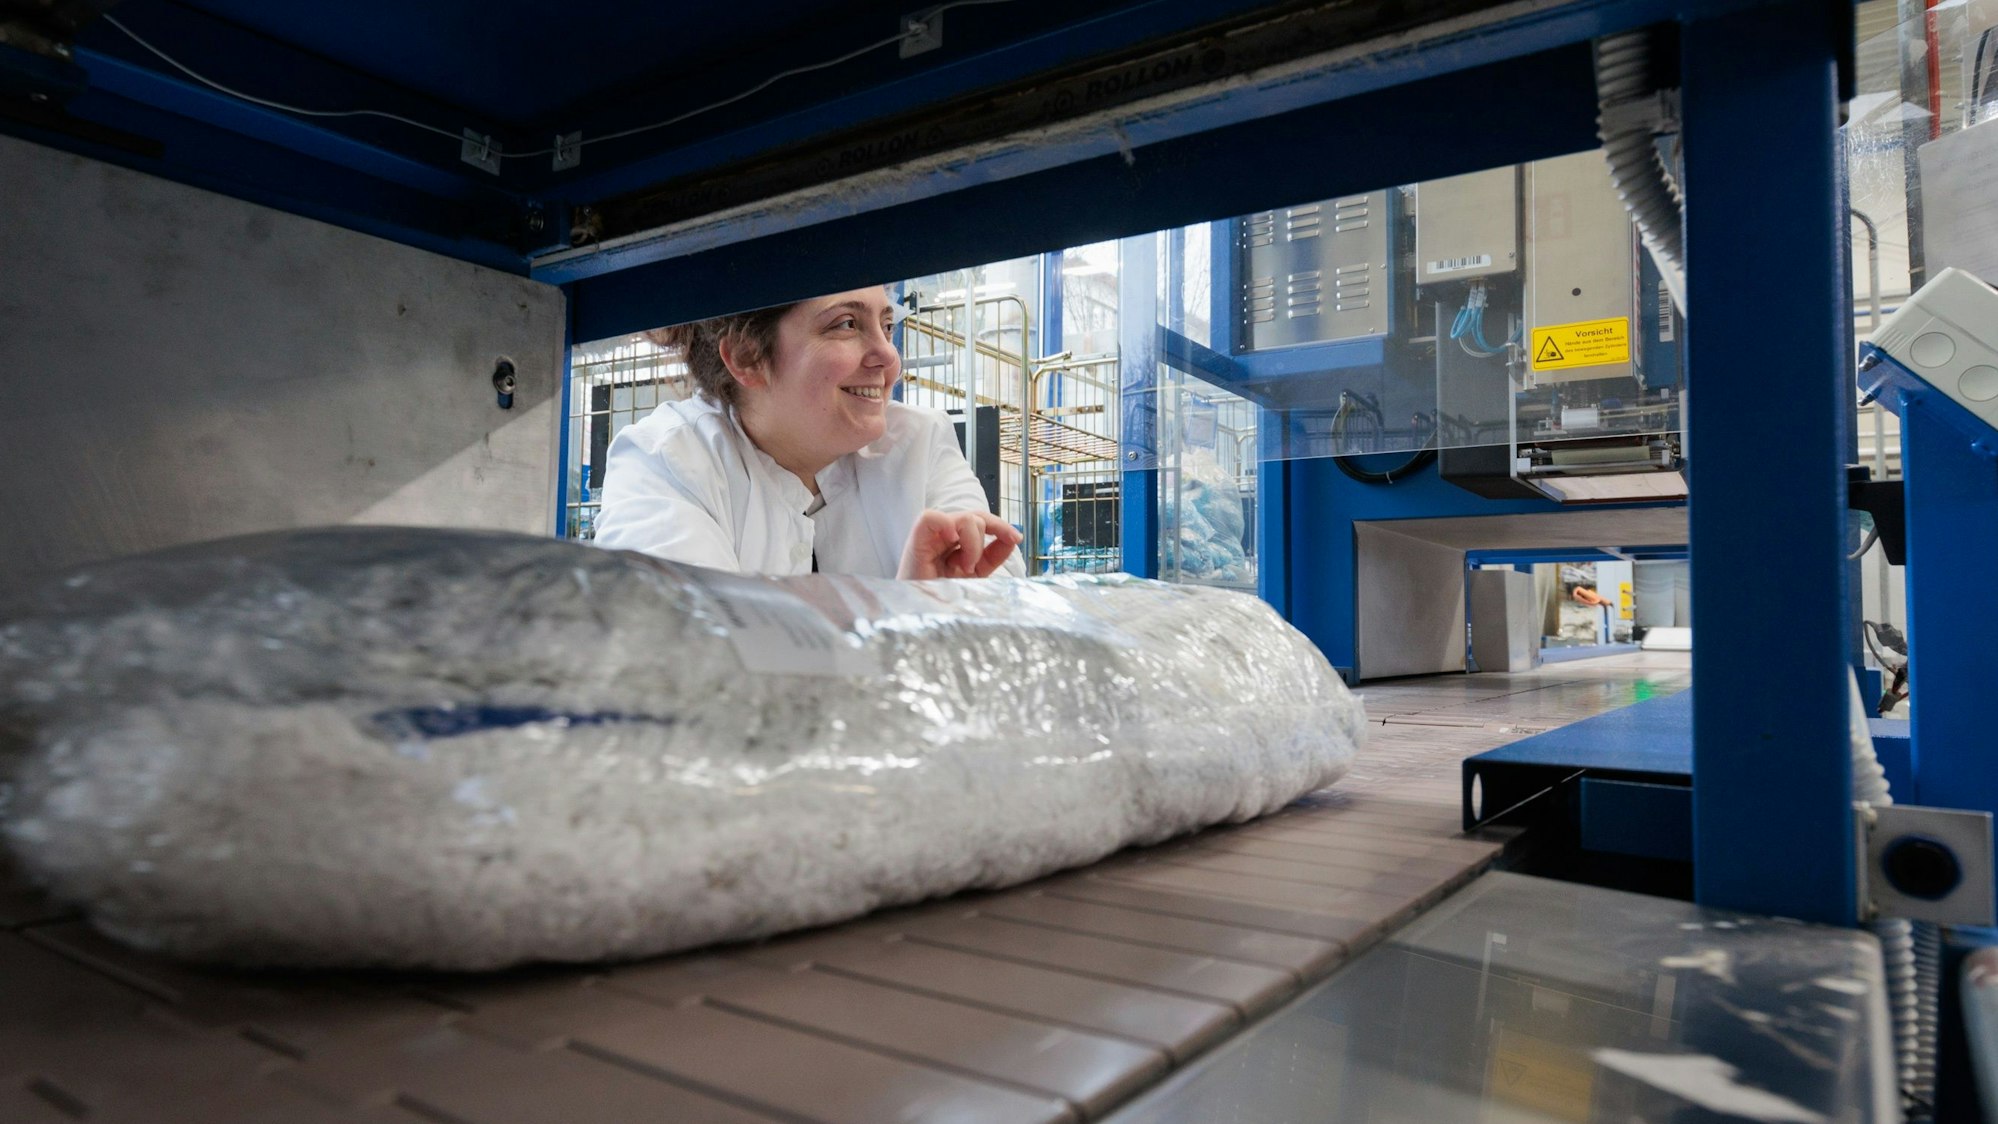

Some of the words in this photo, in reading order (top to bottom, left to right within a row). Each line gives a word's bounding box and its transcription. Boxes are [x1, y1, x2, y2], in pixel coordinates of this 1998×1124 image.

[1085, 54, 1193, 103] ROLLON
[839, 130, 919, 168] ROLLON
[1576, 328, 1612, 337] Vorsicht
